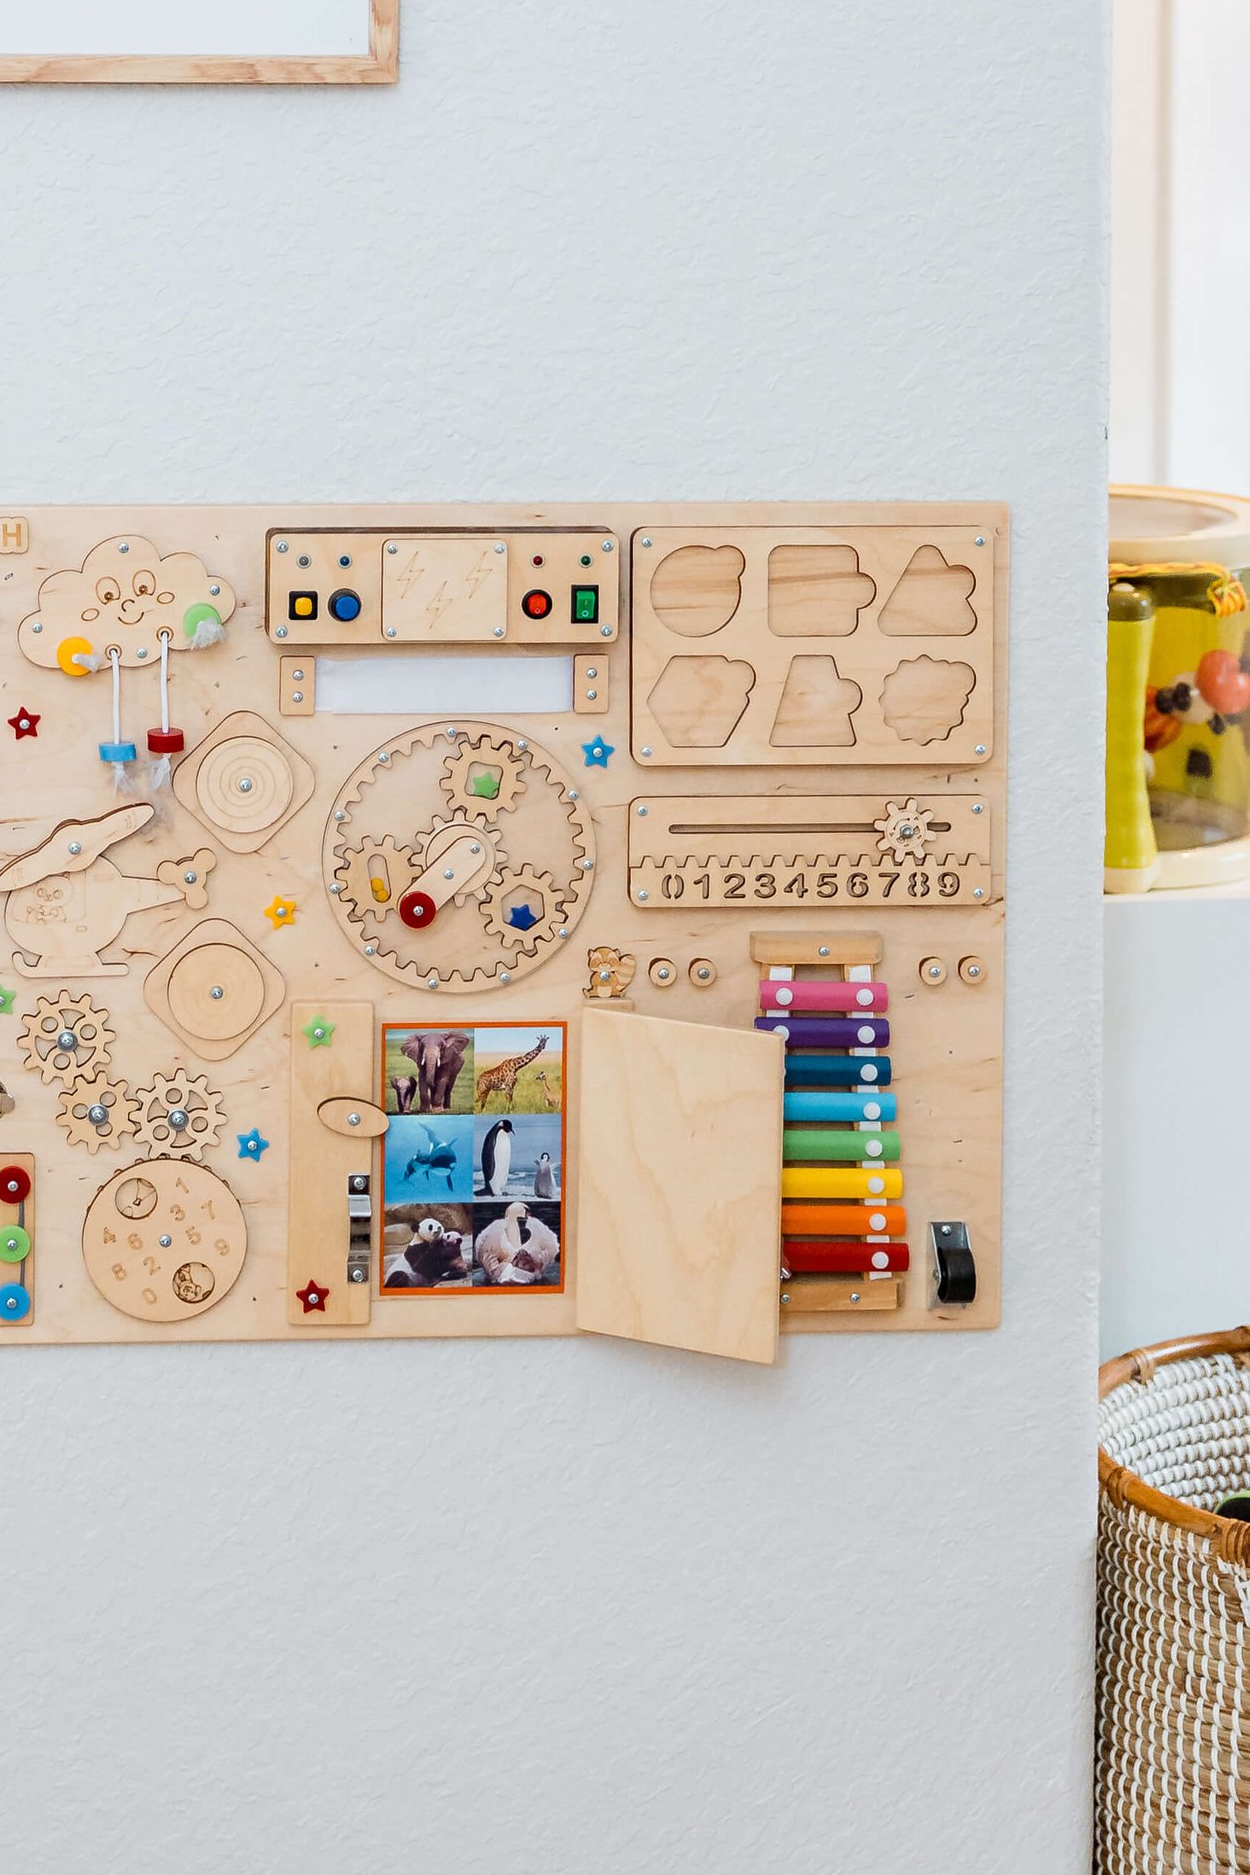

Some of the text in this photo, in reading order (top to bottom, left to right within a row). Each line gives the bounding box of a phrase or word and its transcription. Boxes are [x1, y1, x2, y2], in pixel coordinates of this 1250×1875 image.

[175, 1177, 189, 1194] 1
[170, 1204, 186, 1222] 3
[201, 1199, 215, 1220] 7
[103, 1226, 117, 1244] 4
[127, 1232, 143, 1251] 6
[185, 1226, 202, 1245] 5
[214, 1238, 230, 1256] 9
[111, 1263, 127, 1281] 8
[143, 1256, 161, 1276] 2
[142, 1287, 157, 1305] 0
